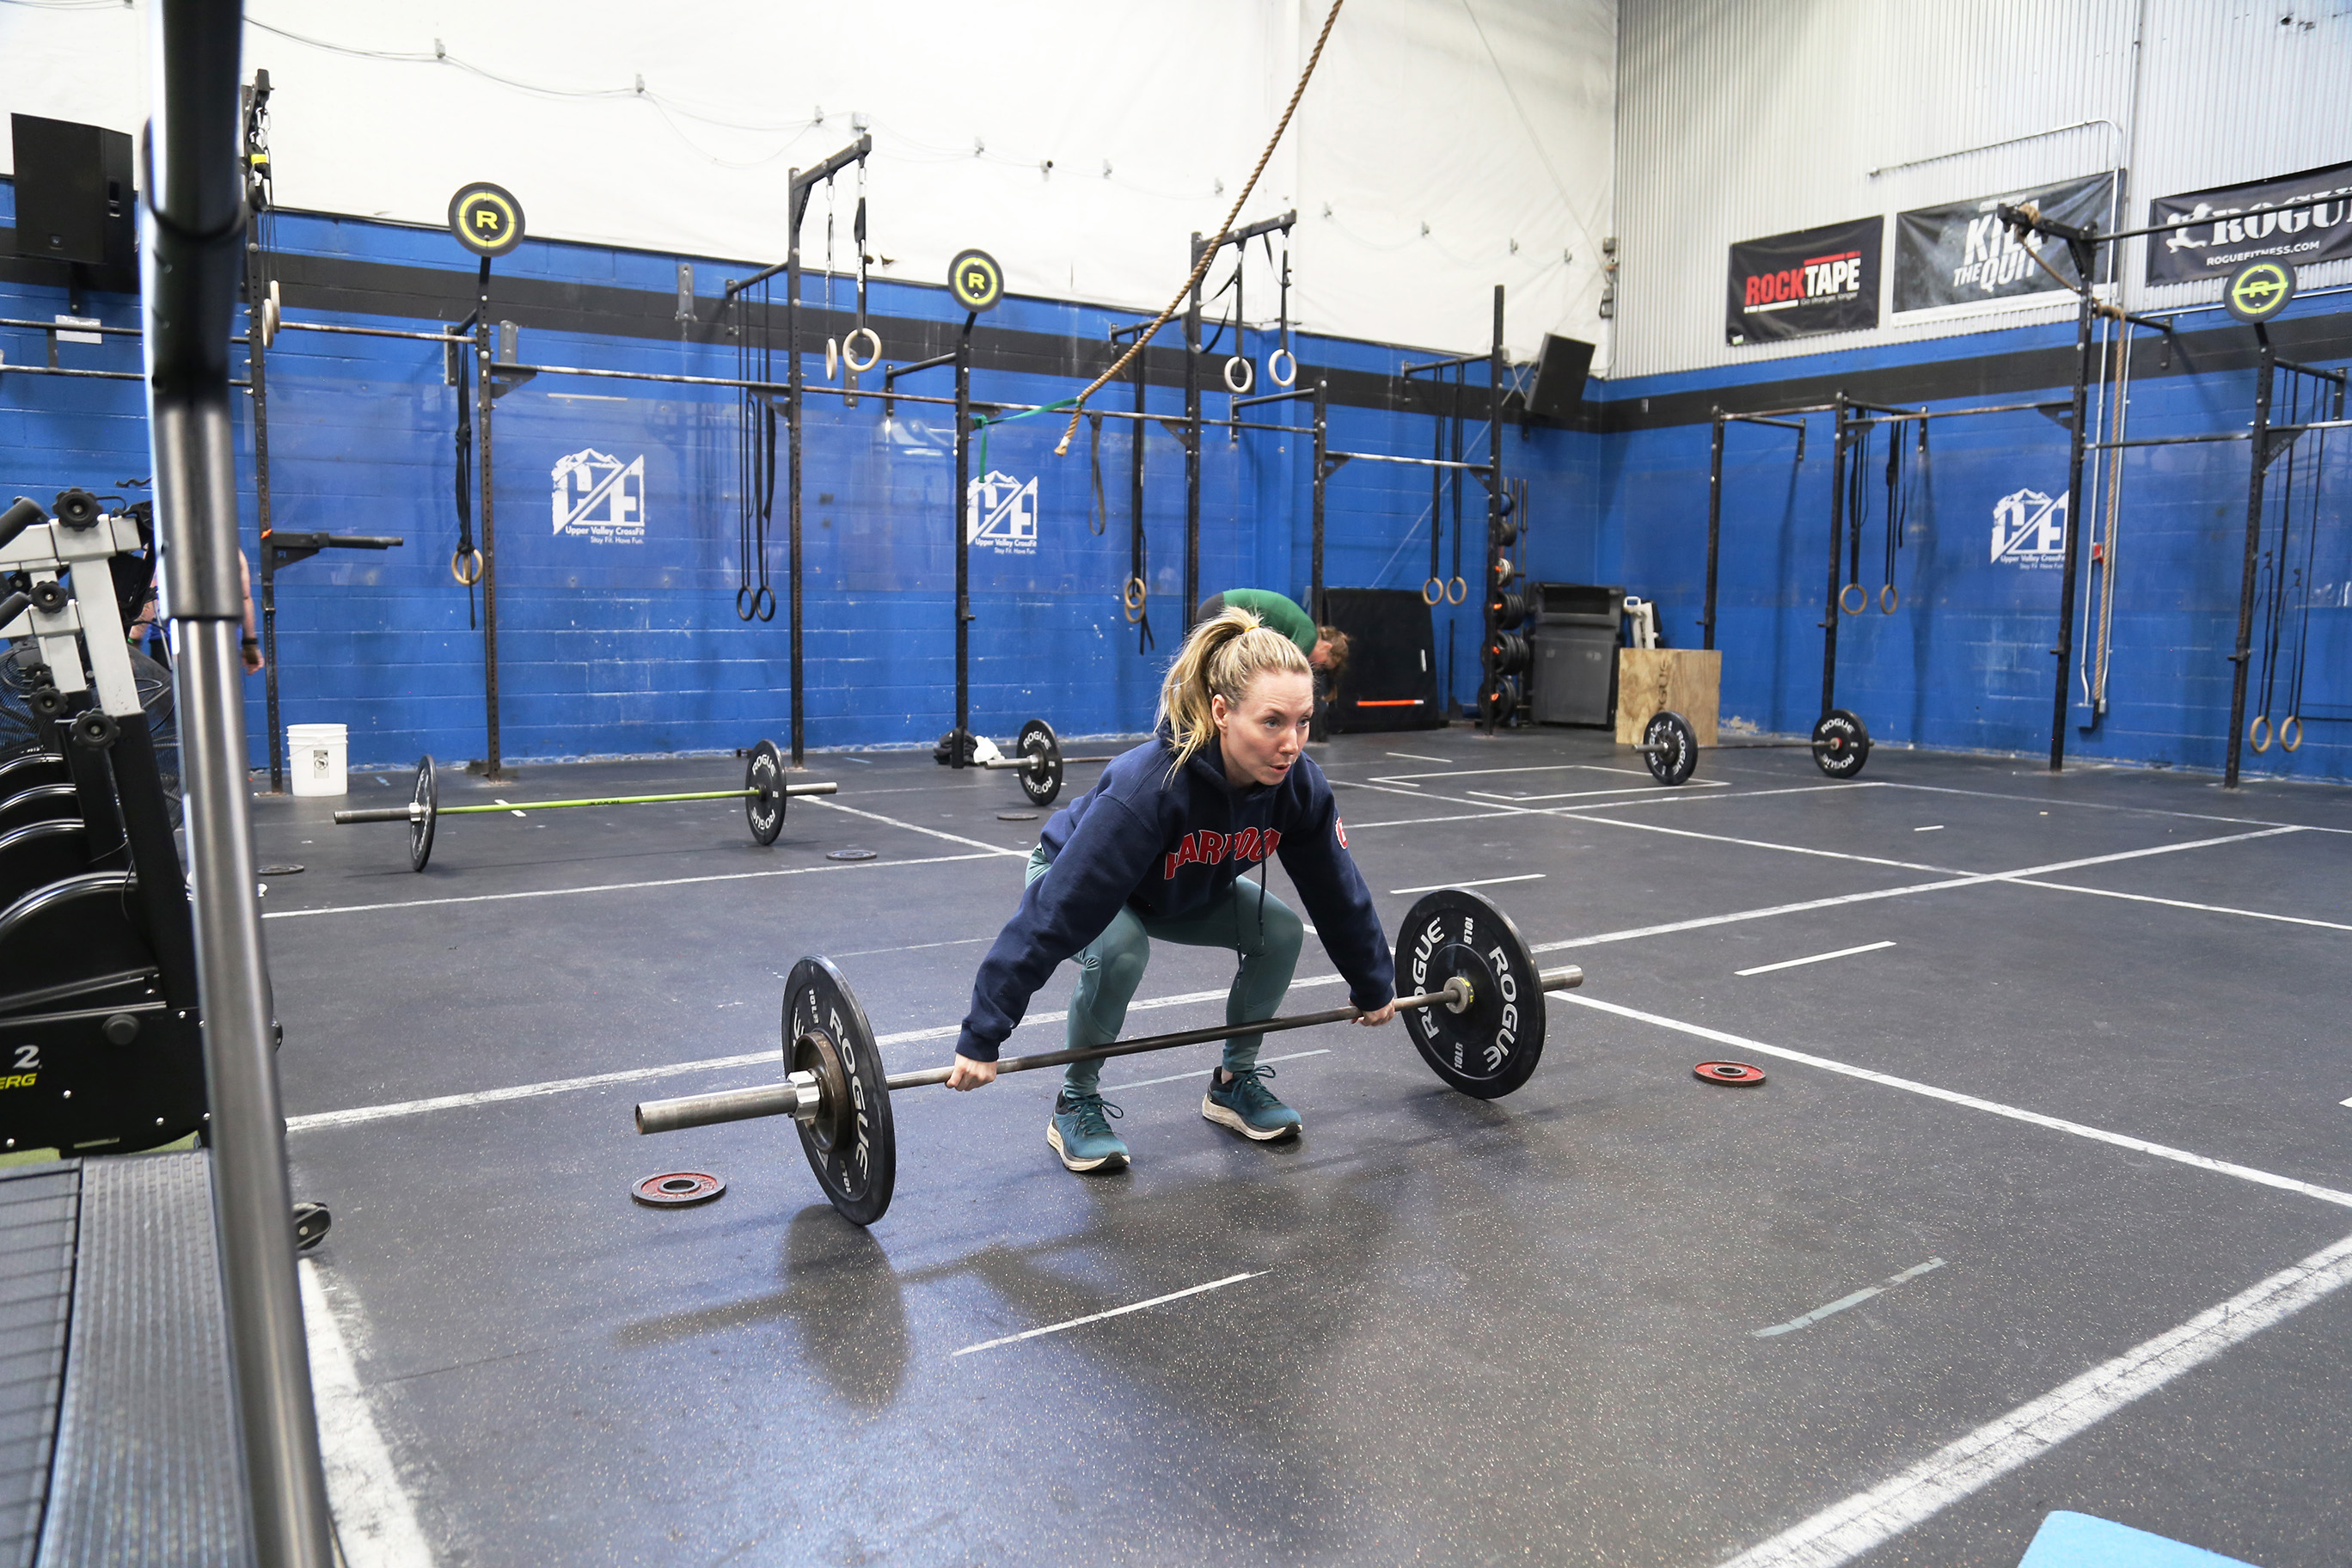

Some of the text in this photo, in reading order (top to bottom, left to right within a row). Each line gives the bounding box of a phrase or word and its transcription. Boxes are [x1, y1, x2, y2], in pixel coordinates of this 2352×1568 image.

[476, 210, 499, 230] R
[2210, 187, 2352, 247] ROGU
[1963, 199, 2042, 266] KILL
[2206, 240, 2320, 266] ROGUEFITNESS.COM
[968, 272, 985, 290] R
[1744, 258, 1861, 306] ROCKTAPE
[1953, 261, 1983, 288] THE
[1980, 247, 2039, 293] QUIT
[565, 525, 645, 536] Upper Valley CrossFit
[975, 537, 1037, 548] Upper Valley CrossFit
[1821, 717, 1855, 735] ROGUE
[1022, 730, 1052, 750] ROGUE
[1672, 730, 1686, 775] ROGUE
[751, 754, 777, 777] ROGUE
[1412, 916, 1445, 1040] ROGUE
[1483, 946, 1519, 1072] ROGUE
[830, 1007, 869, 1180] ROGUE
